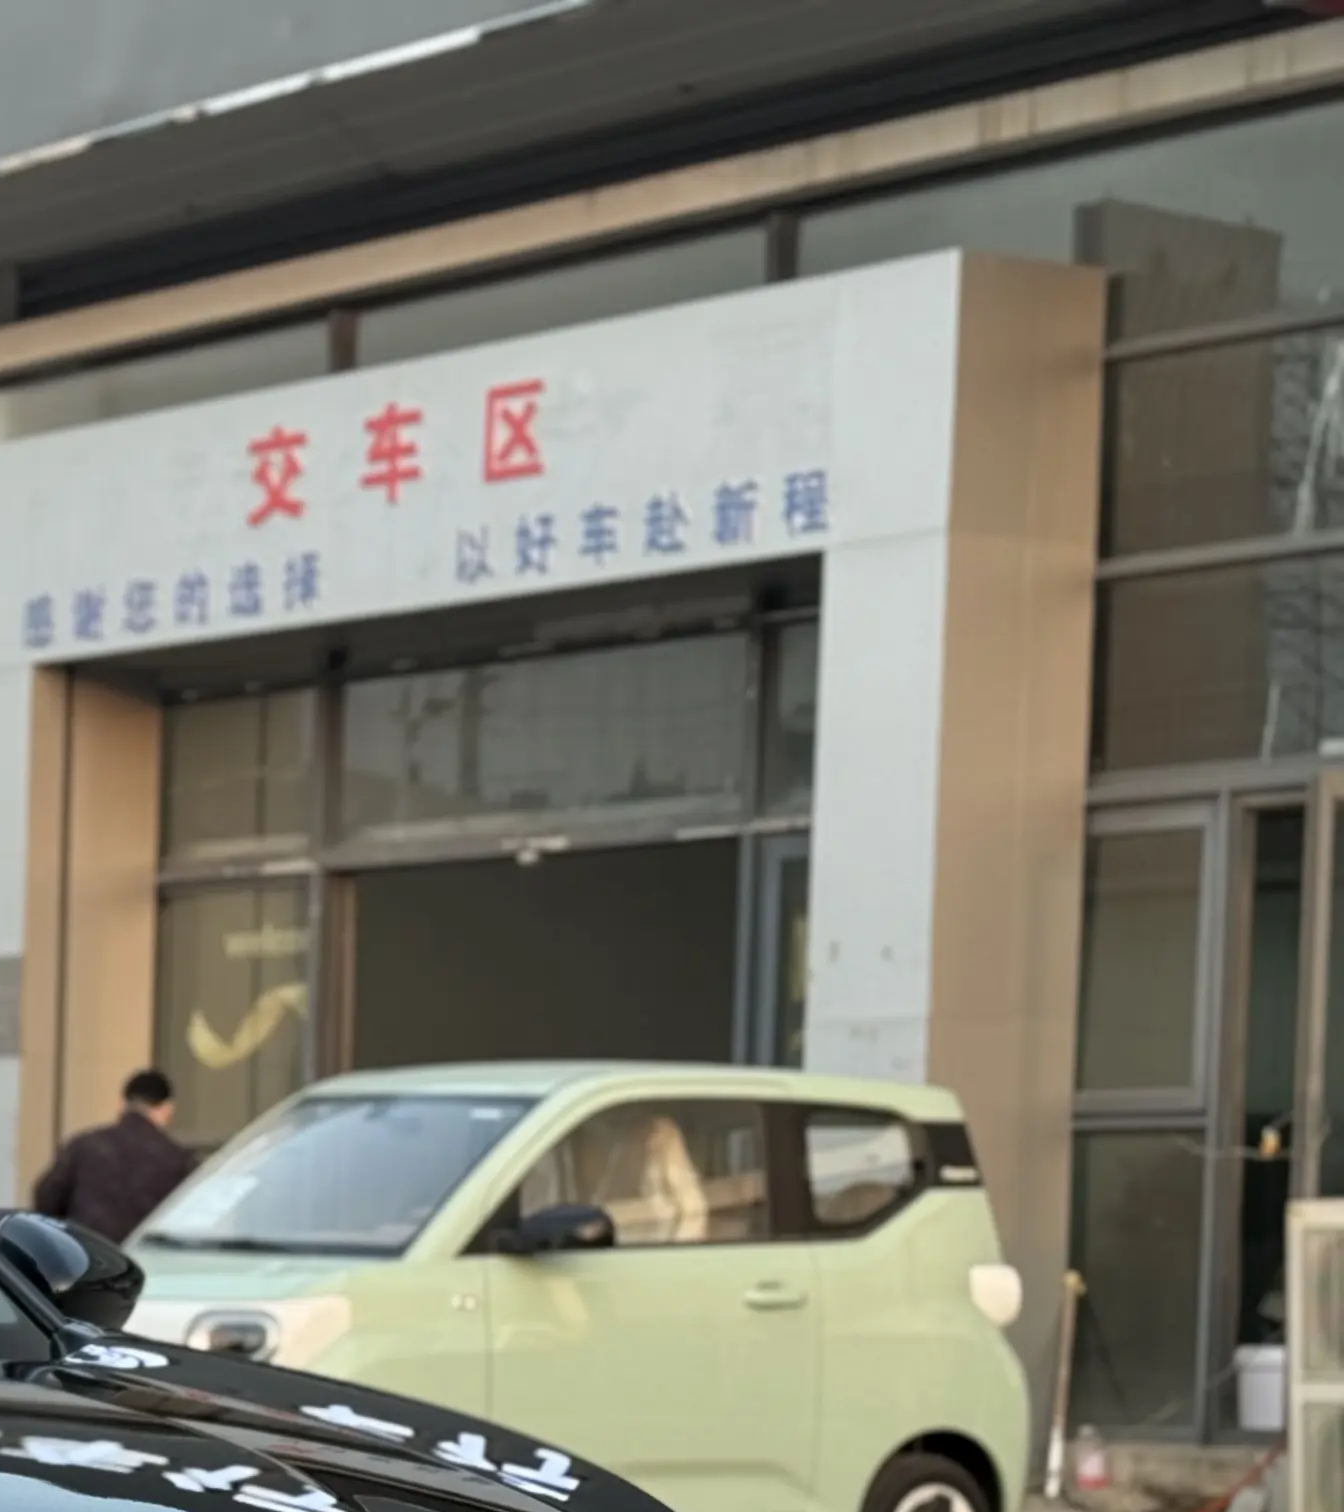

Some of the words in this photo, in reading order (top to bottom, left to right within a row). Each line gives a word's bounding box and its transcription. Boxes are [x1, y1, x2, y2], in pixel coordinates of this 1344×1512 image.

[245, 378, 547, 528] 交车区
[22, 549, 320, 649] 感谢您的选择
[455, 469, 829, 585] 以好车赴新程
